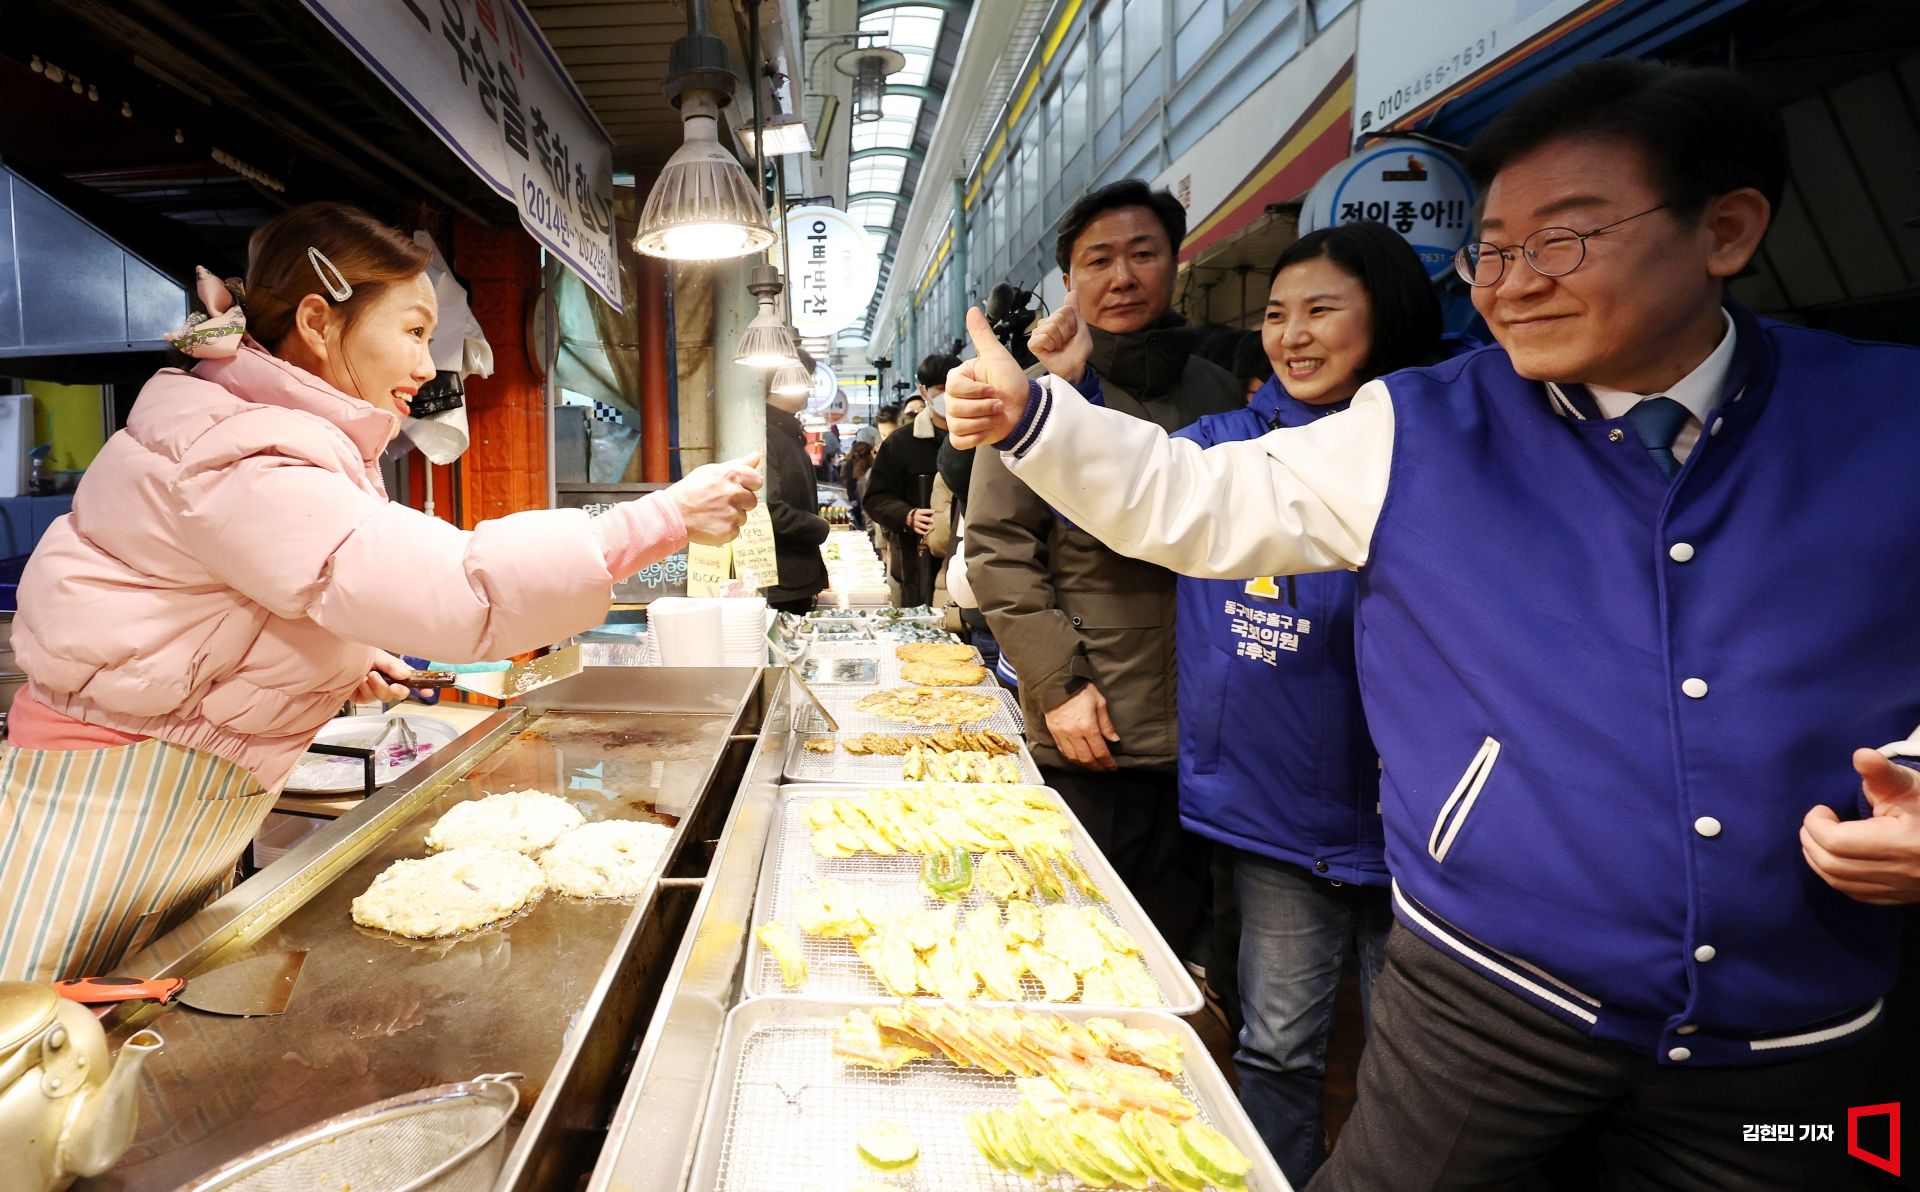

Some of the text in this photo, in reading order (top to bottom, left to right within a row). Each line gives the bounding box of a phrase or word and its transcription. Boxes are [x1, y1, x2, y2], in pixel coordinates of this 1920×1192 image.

[530, 105, 573, 213] 축하
[803, 220, 828, 316] 아빠반찬
[1230, 618, 1299, 652] 국회의원
